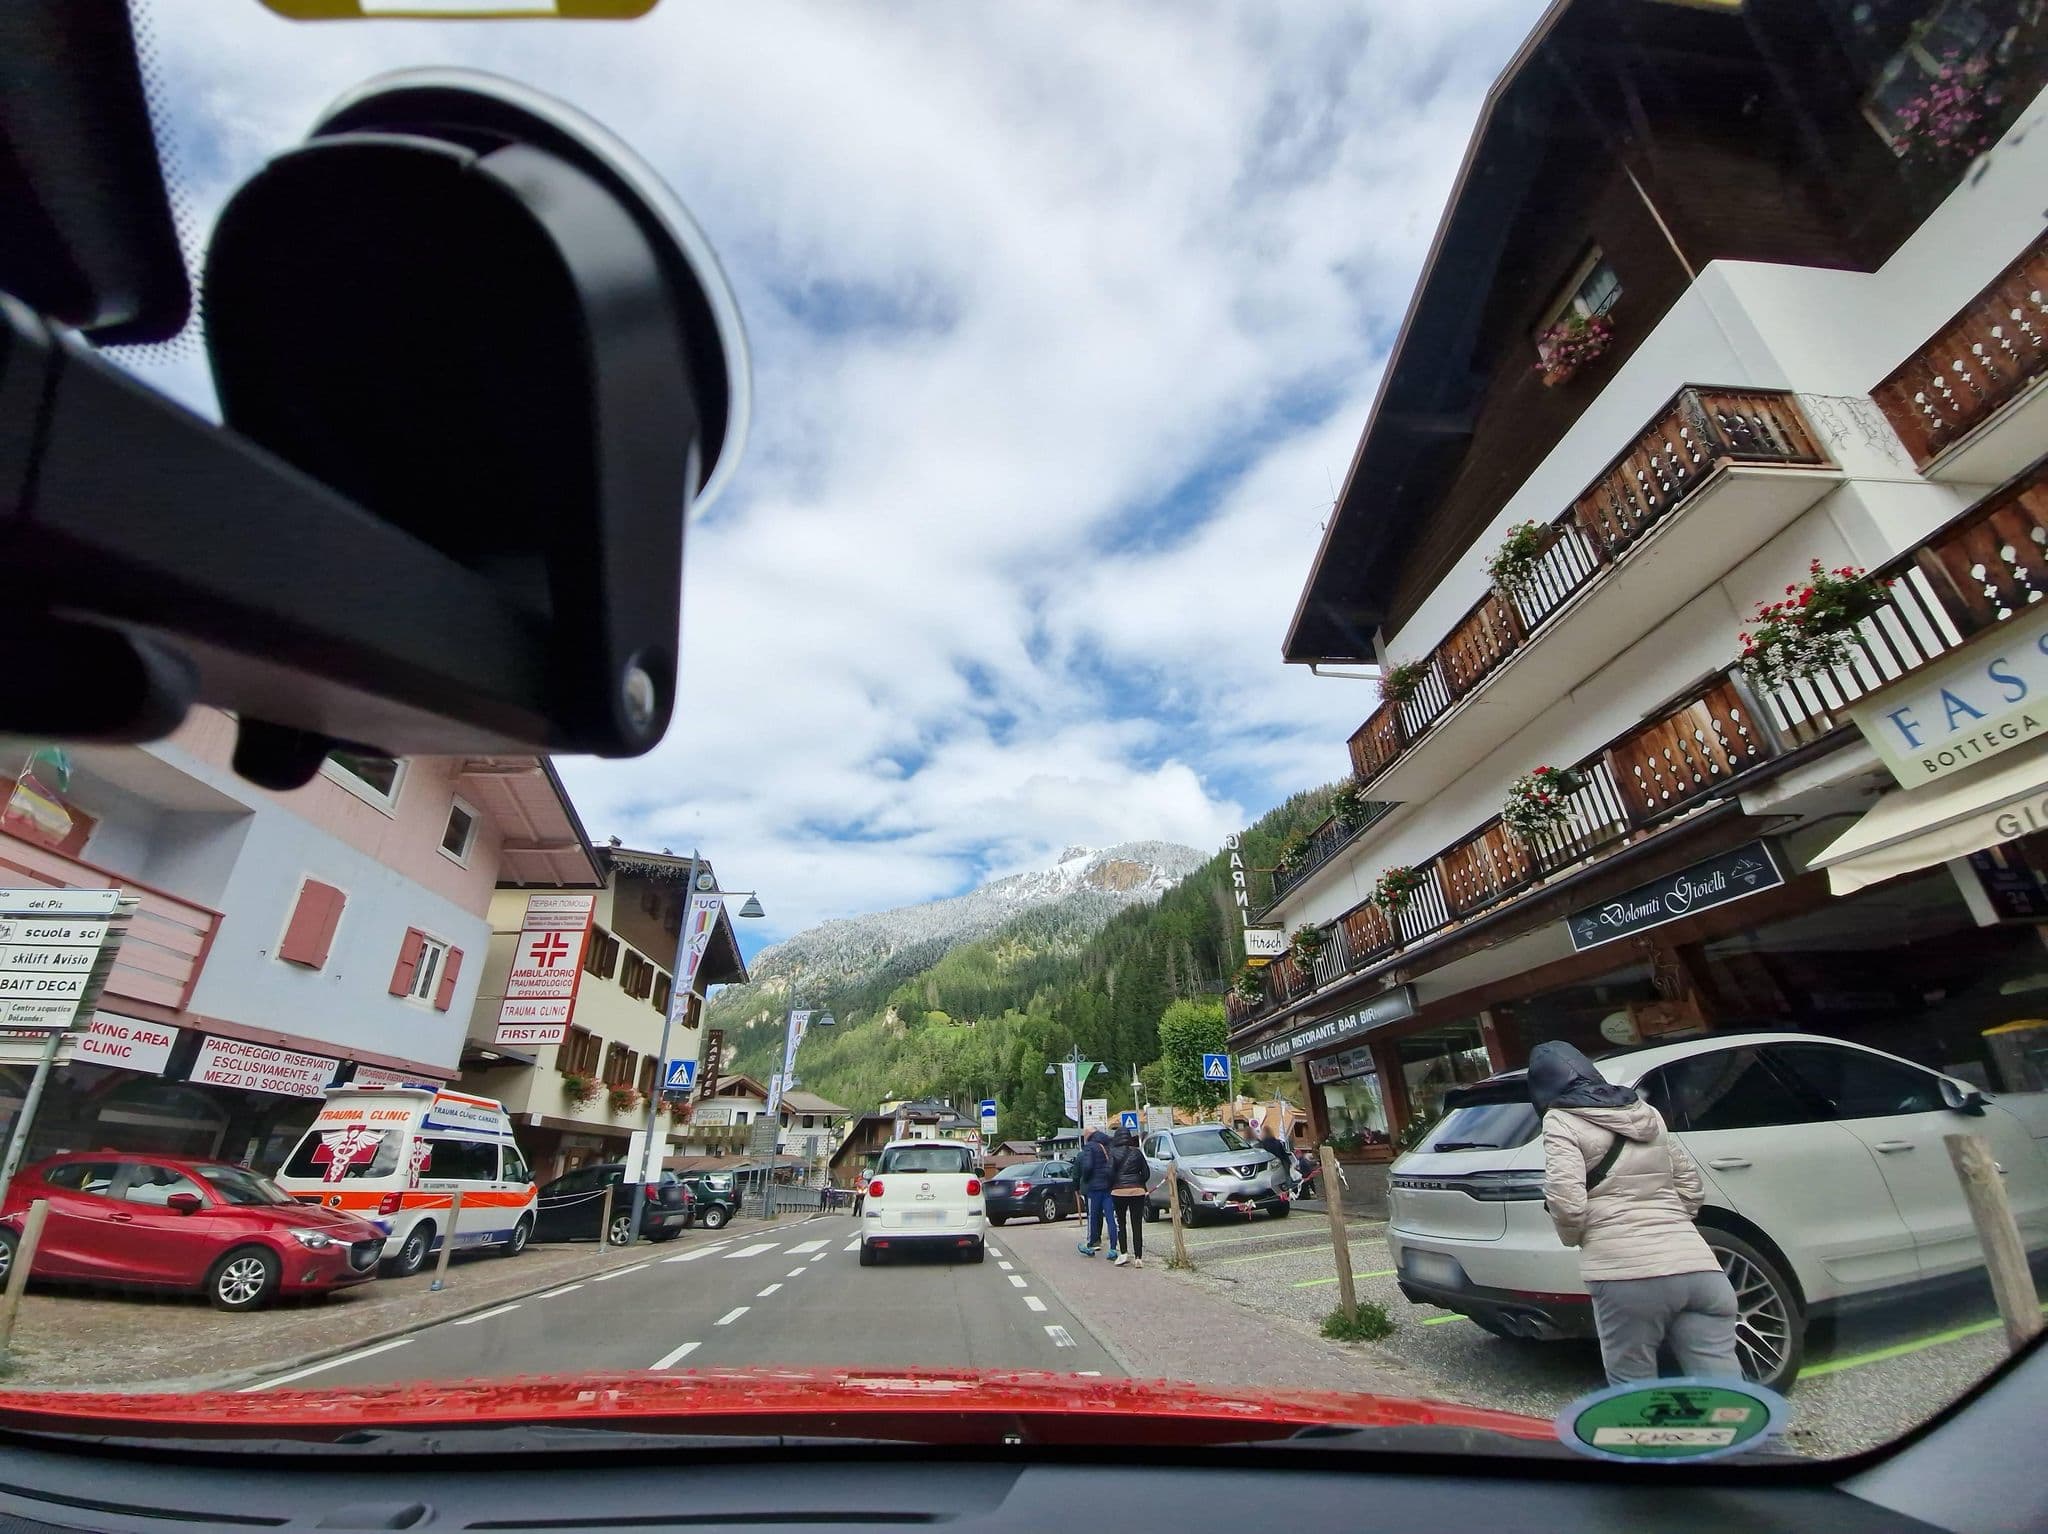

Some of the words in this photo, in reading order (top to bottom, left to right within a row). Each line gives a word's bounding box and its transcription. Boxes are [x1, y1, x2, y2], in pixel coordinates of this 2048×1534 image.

[1922, 715, 2040, 773] BOTTEGA
[28, 900, 45, 908] del
[1600, 896, 1660, 926] Dolomiti
[1664, 870, 1727, 914] Gioielli
[25, 927, 71, 938] scuola
[79, 929, 101, 939] sci
[1249, 934, 1282, 952] Hirsch
[11, 953, 48, 964] skilift
[52, 953, 89, 965] Avisio
[512, 969, 575, 977] AMBULATORIO
[0, 979, 34, 990] BAIT
[505, 1006, 537, 1016] TRAUMA
[540, 1006, 567, 1016] CLINIC
[131, 1031, 169, 1047] AREA
[501, 1030, 536, 1038] FIRST
[539, 1030, 560, 1038] AID
[1291, 1023, 1337, 1049] RISTORANTE
[1338, 1014, 1357, 1032] BAR
[83, 1039, 132, 1058] CLINIC
[206, 1039, 281, 1062] PARCHEGGIO
[283, 1053, 336, 1071] RISERVATO
[213, 1056, 309, 1081] ESCLUSIVAMENTE
[312, 1074, 321, 1082] AI
[703, 1038, 719, 1097] LASTIES
[204, 1070, 241, 1085] MEZZI
[245, 1077, 257, 1087] DI
[260, 1079, 319, 1096] SOCCORSO
[319, 1110, 364, 1120] TRAUMA
[370, 1110, 410, 1121] CLINIC
[434, 1106, 458, 1116] TRAUMA
[459, 1110, 477, 1120] CLINIC
